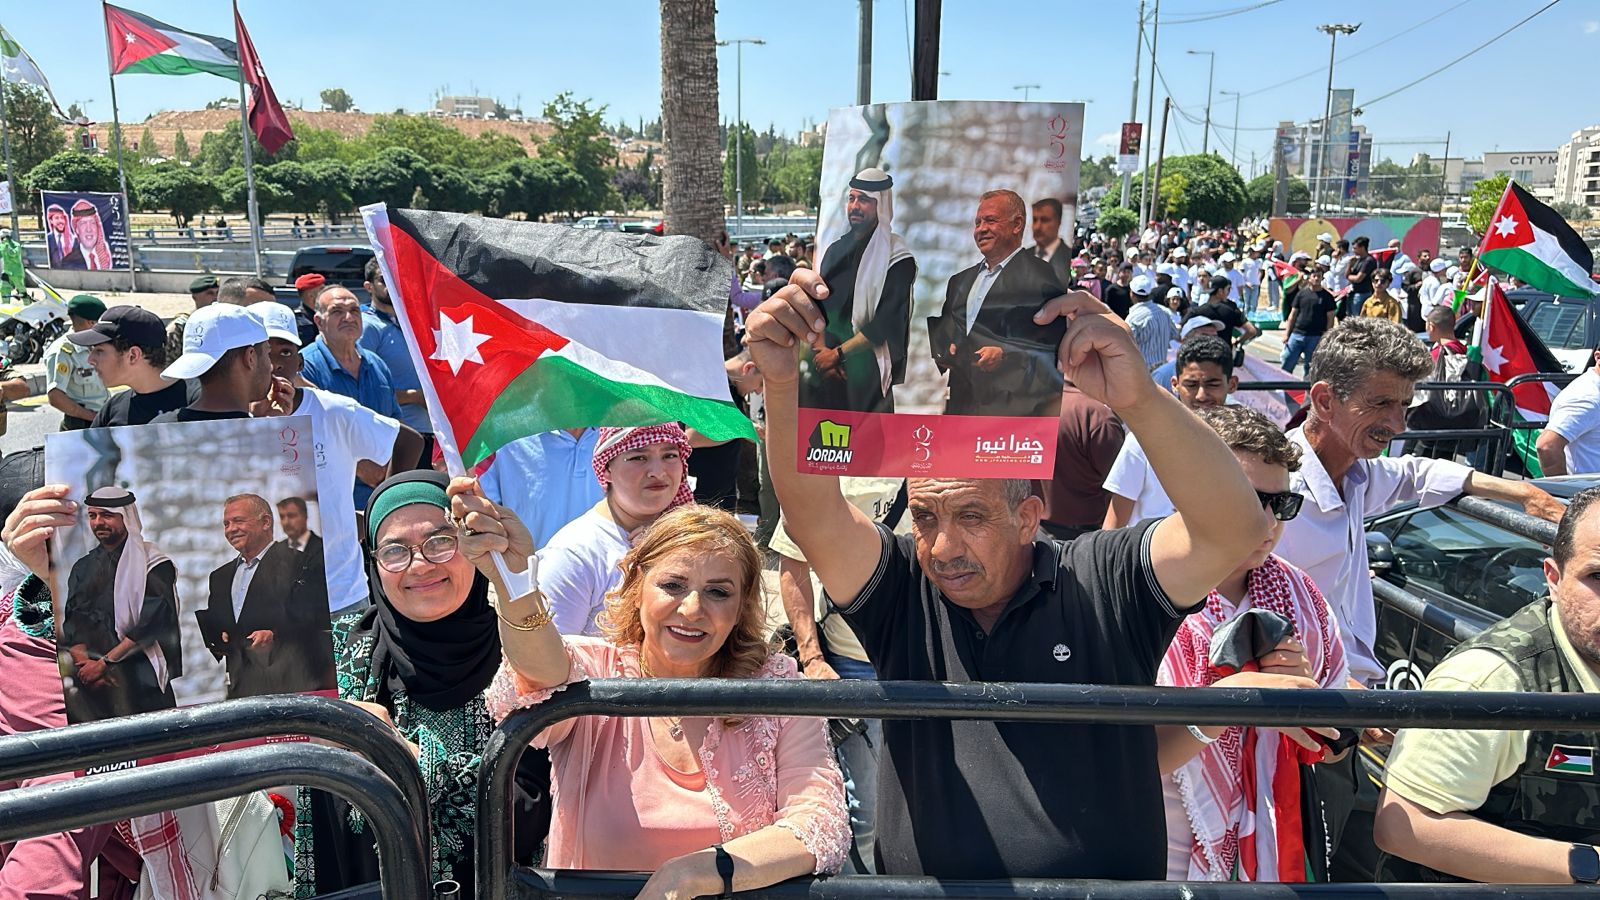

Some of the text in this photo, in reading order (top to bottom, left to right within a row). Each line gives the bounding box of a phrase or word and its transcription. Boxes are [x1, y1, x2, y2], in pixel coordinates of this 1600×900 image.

[1510, 156, 1558, 165] CITYM
[975, 434, 1044, 454] جفرا نيوز
[807, 448, 853, 463] JORDAN
